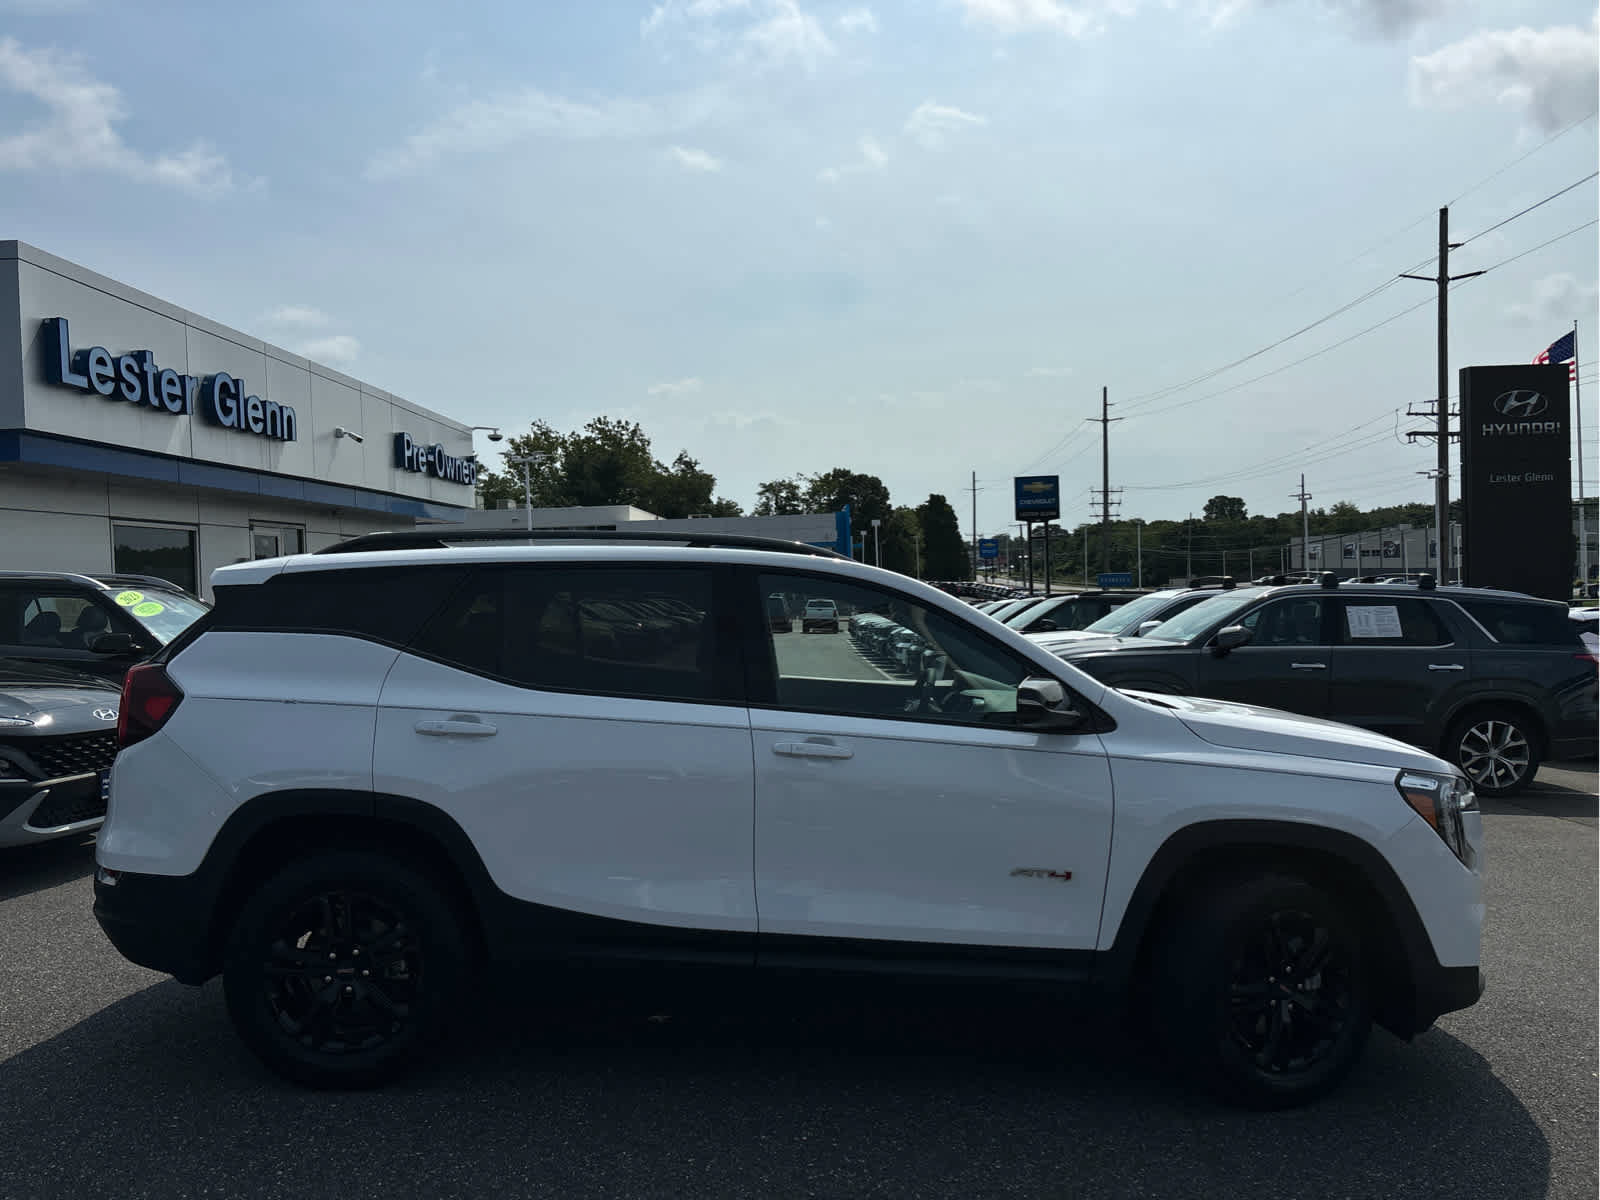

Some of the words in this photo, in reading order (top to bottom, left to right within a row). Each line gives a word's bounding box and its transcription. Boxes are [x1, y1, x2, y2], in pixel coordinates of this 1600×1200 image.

[57, 317, 199, 416] Lester
[213, 371, 297, 441] Glenn
[1481, 422, 1561, 436] HYUNDAI
[403, 432, 477, 485] Pre-Owned
[1489, 472, 1521, 483] Lester
[1524, 471, 1555, 482] Glenn
